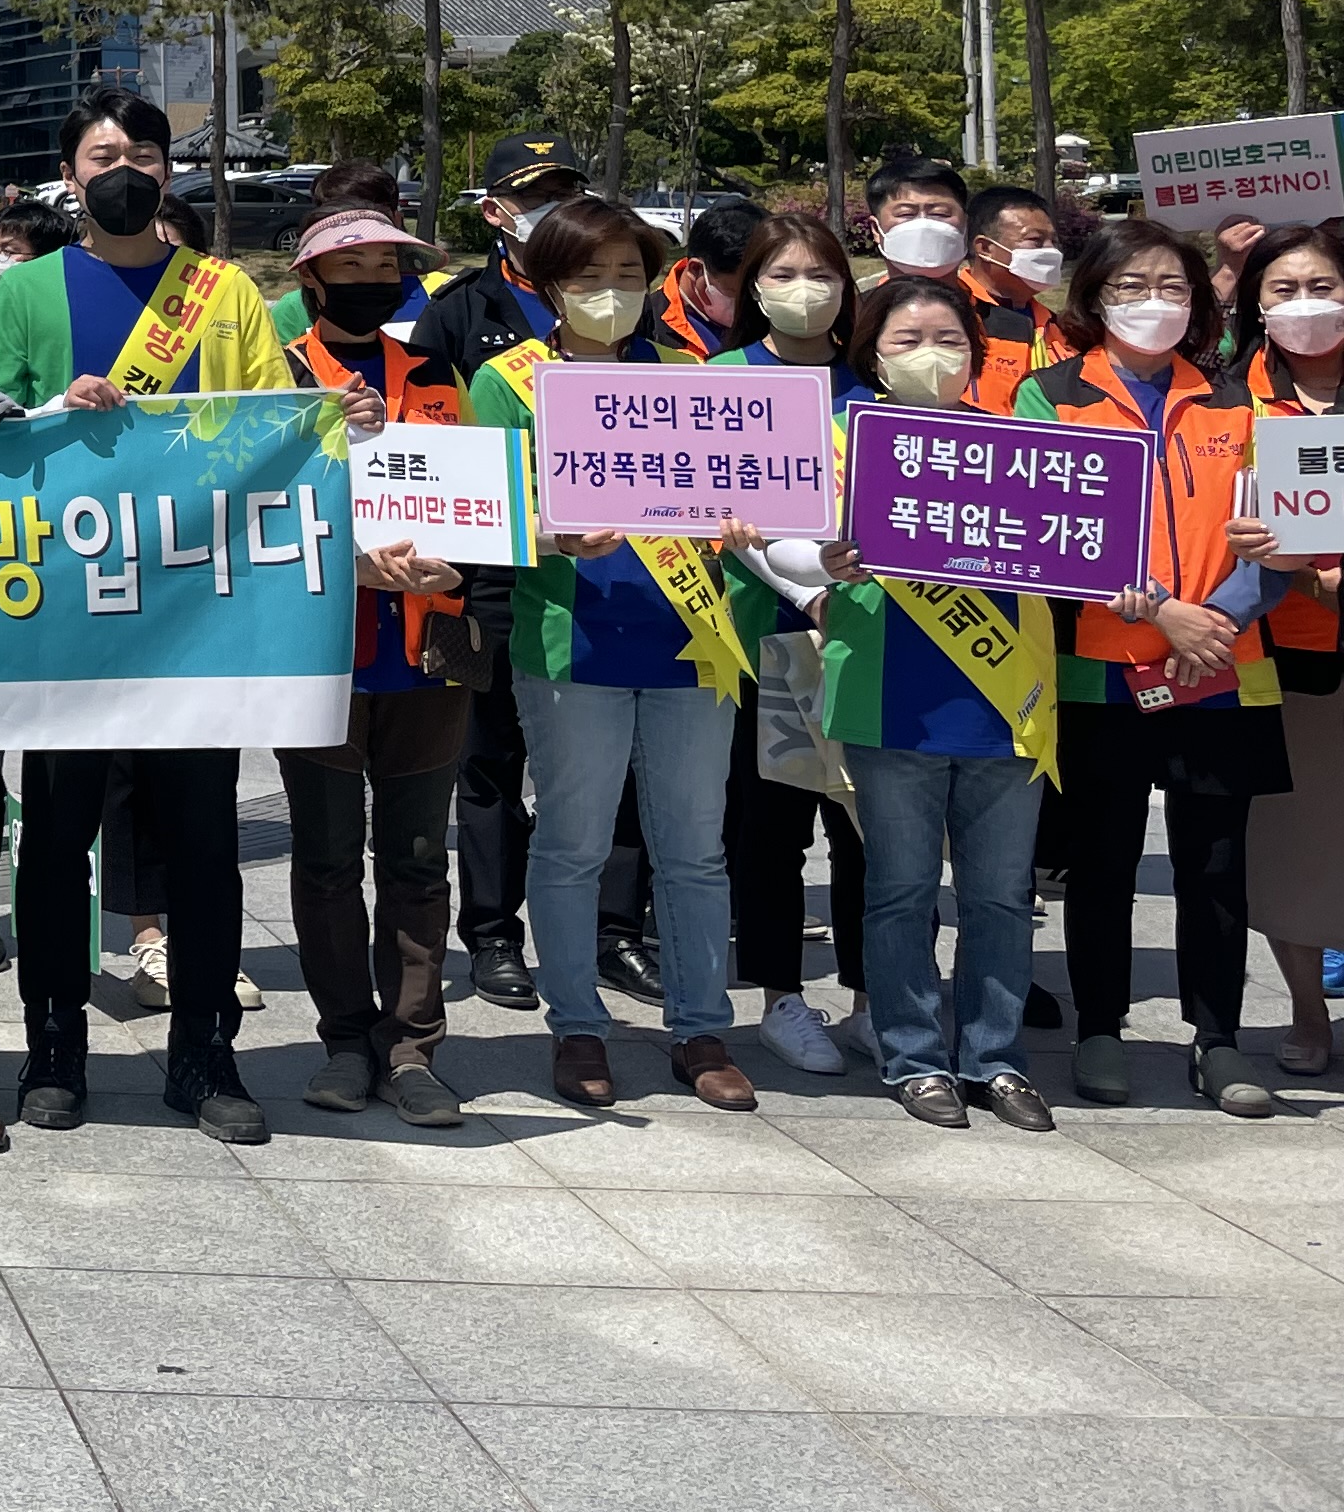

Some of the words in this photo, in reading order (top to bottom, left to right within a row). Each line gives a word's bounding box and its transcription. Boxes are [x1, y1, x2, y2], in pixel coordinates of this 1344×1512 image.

[1152, 139, 1326, 174] 어린이보호구역..
[1155, 183, 1199, 207] 불법
[144, 294, 204, 364] 예방
[594, 394, 677, 430] 당신의
[689, 396, 773, 431] 관심이
[368, 452, 439, 481] 스쿨존..
[553, 450, 696, 490] 가정폭력을
[707, 453, 823, 491] 멈춥니다
[893, 434, 995, 485] 행복의
[1006, 448, 1109, 496] 시작은
[453, 498, 502, 527] 운전!
[641, 505, 680, 518] Jindo
[1273, 489, 1331, 517] NO
[888, 496, 1026, 551] 폭력없는
[1039, 514, 1105, 561] 가정
